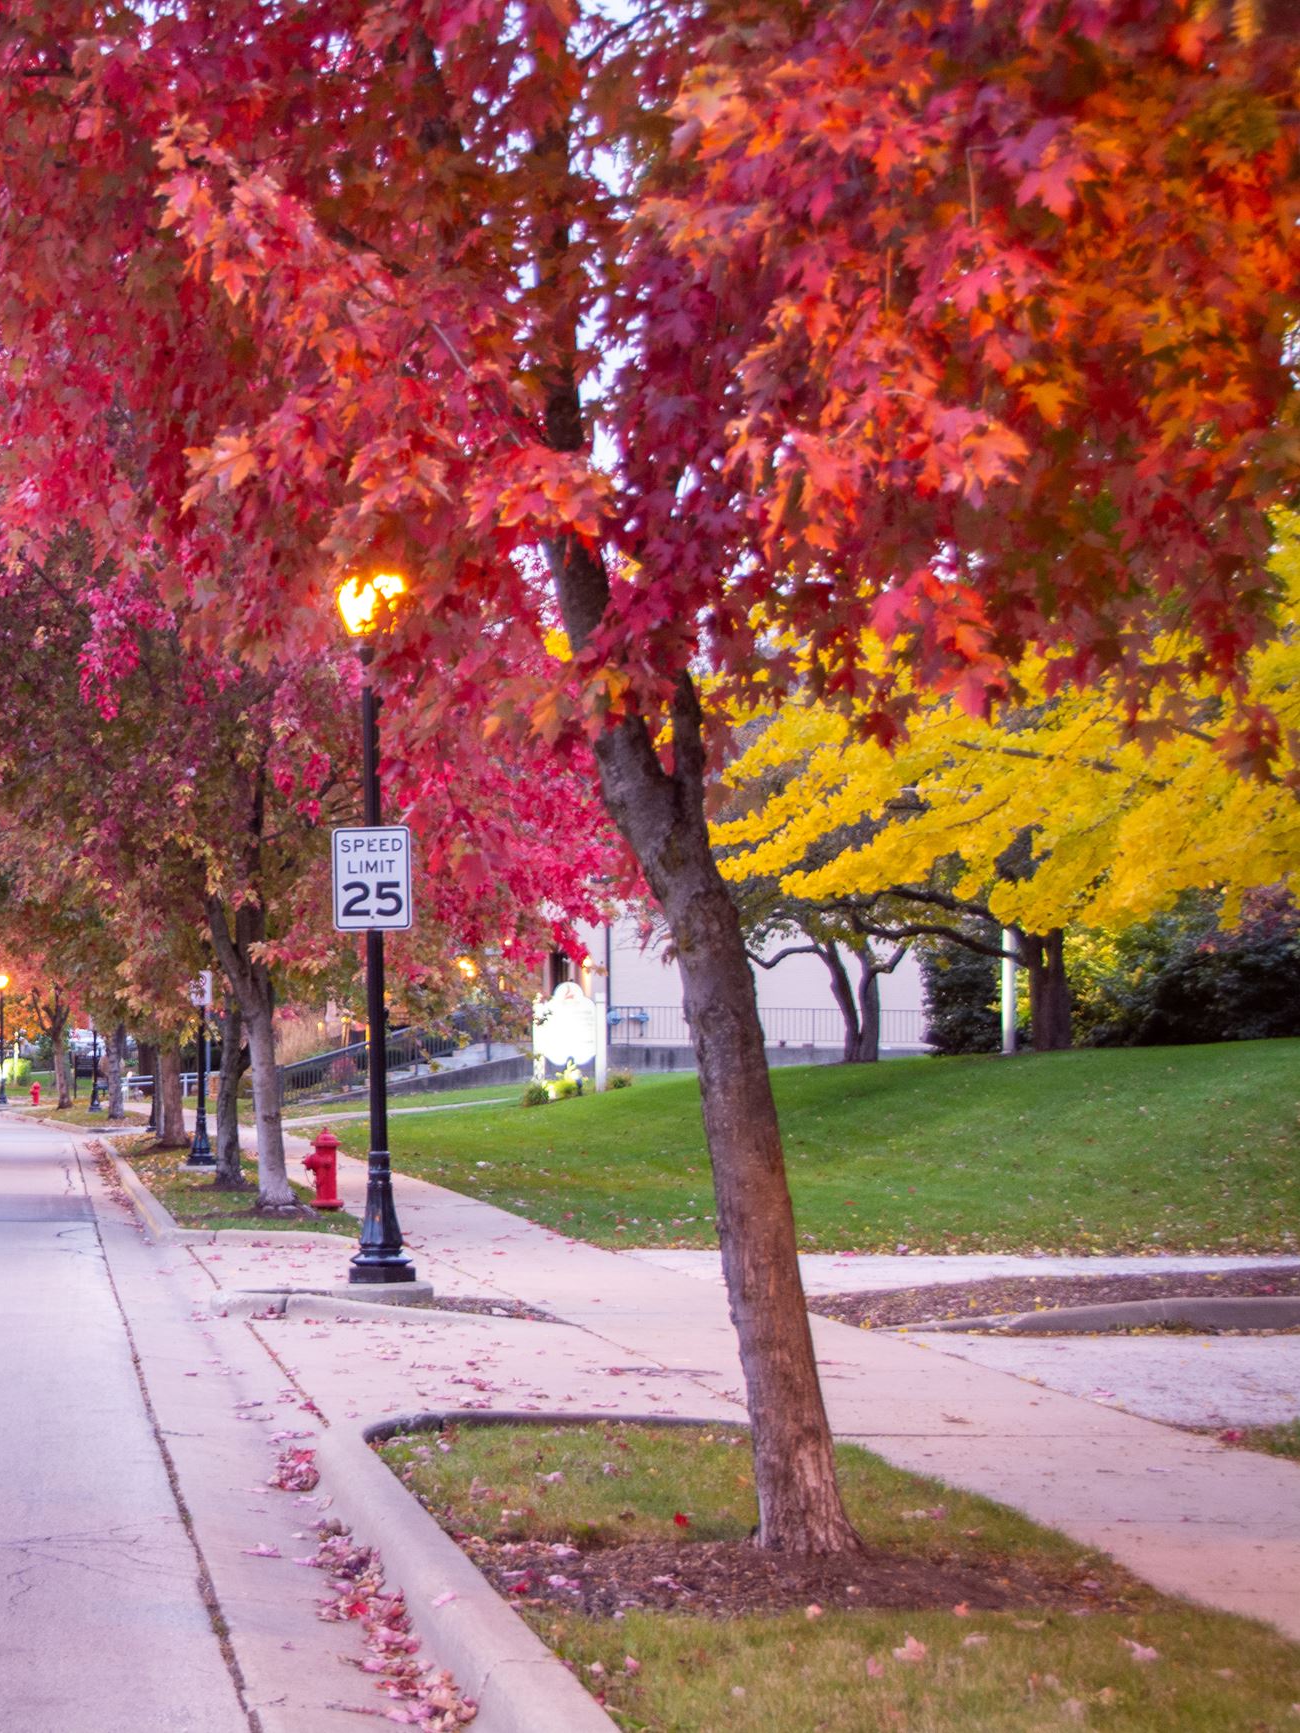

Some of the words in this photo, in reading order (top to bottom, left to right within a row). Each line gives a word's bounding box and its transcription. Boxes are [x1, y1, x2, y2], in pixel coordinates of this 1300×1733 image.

[341, 838, 403, 853] SPEED
[347, 859, 396, 874] LIMIT
[342, 881, 403, 917] 25
